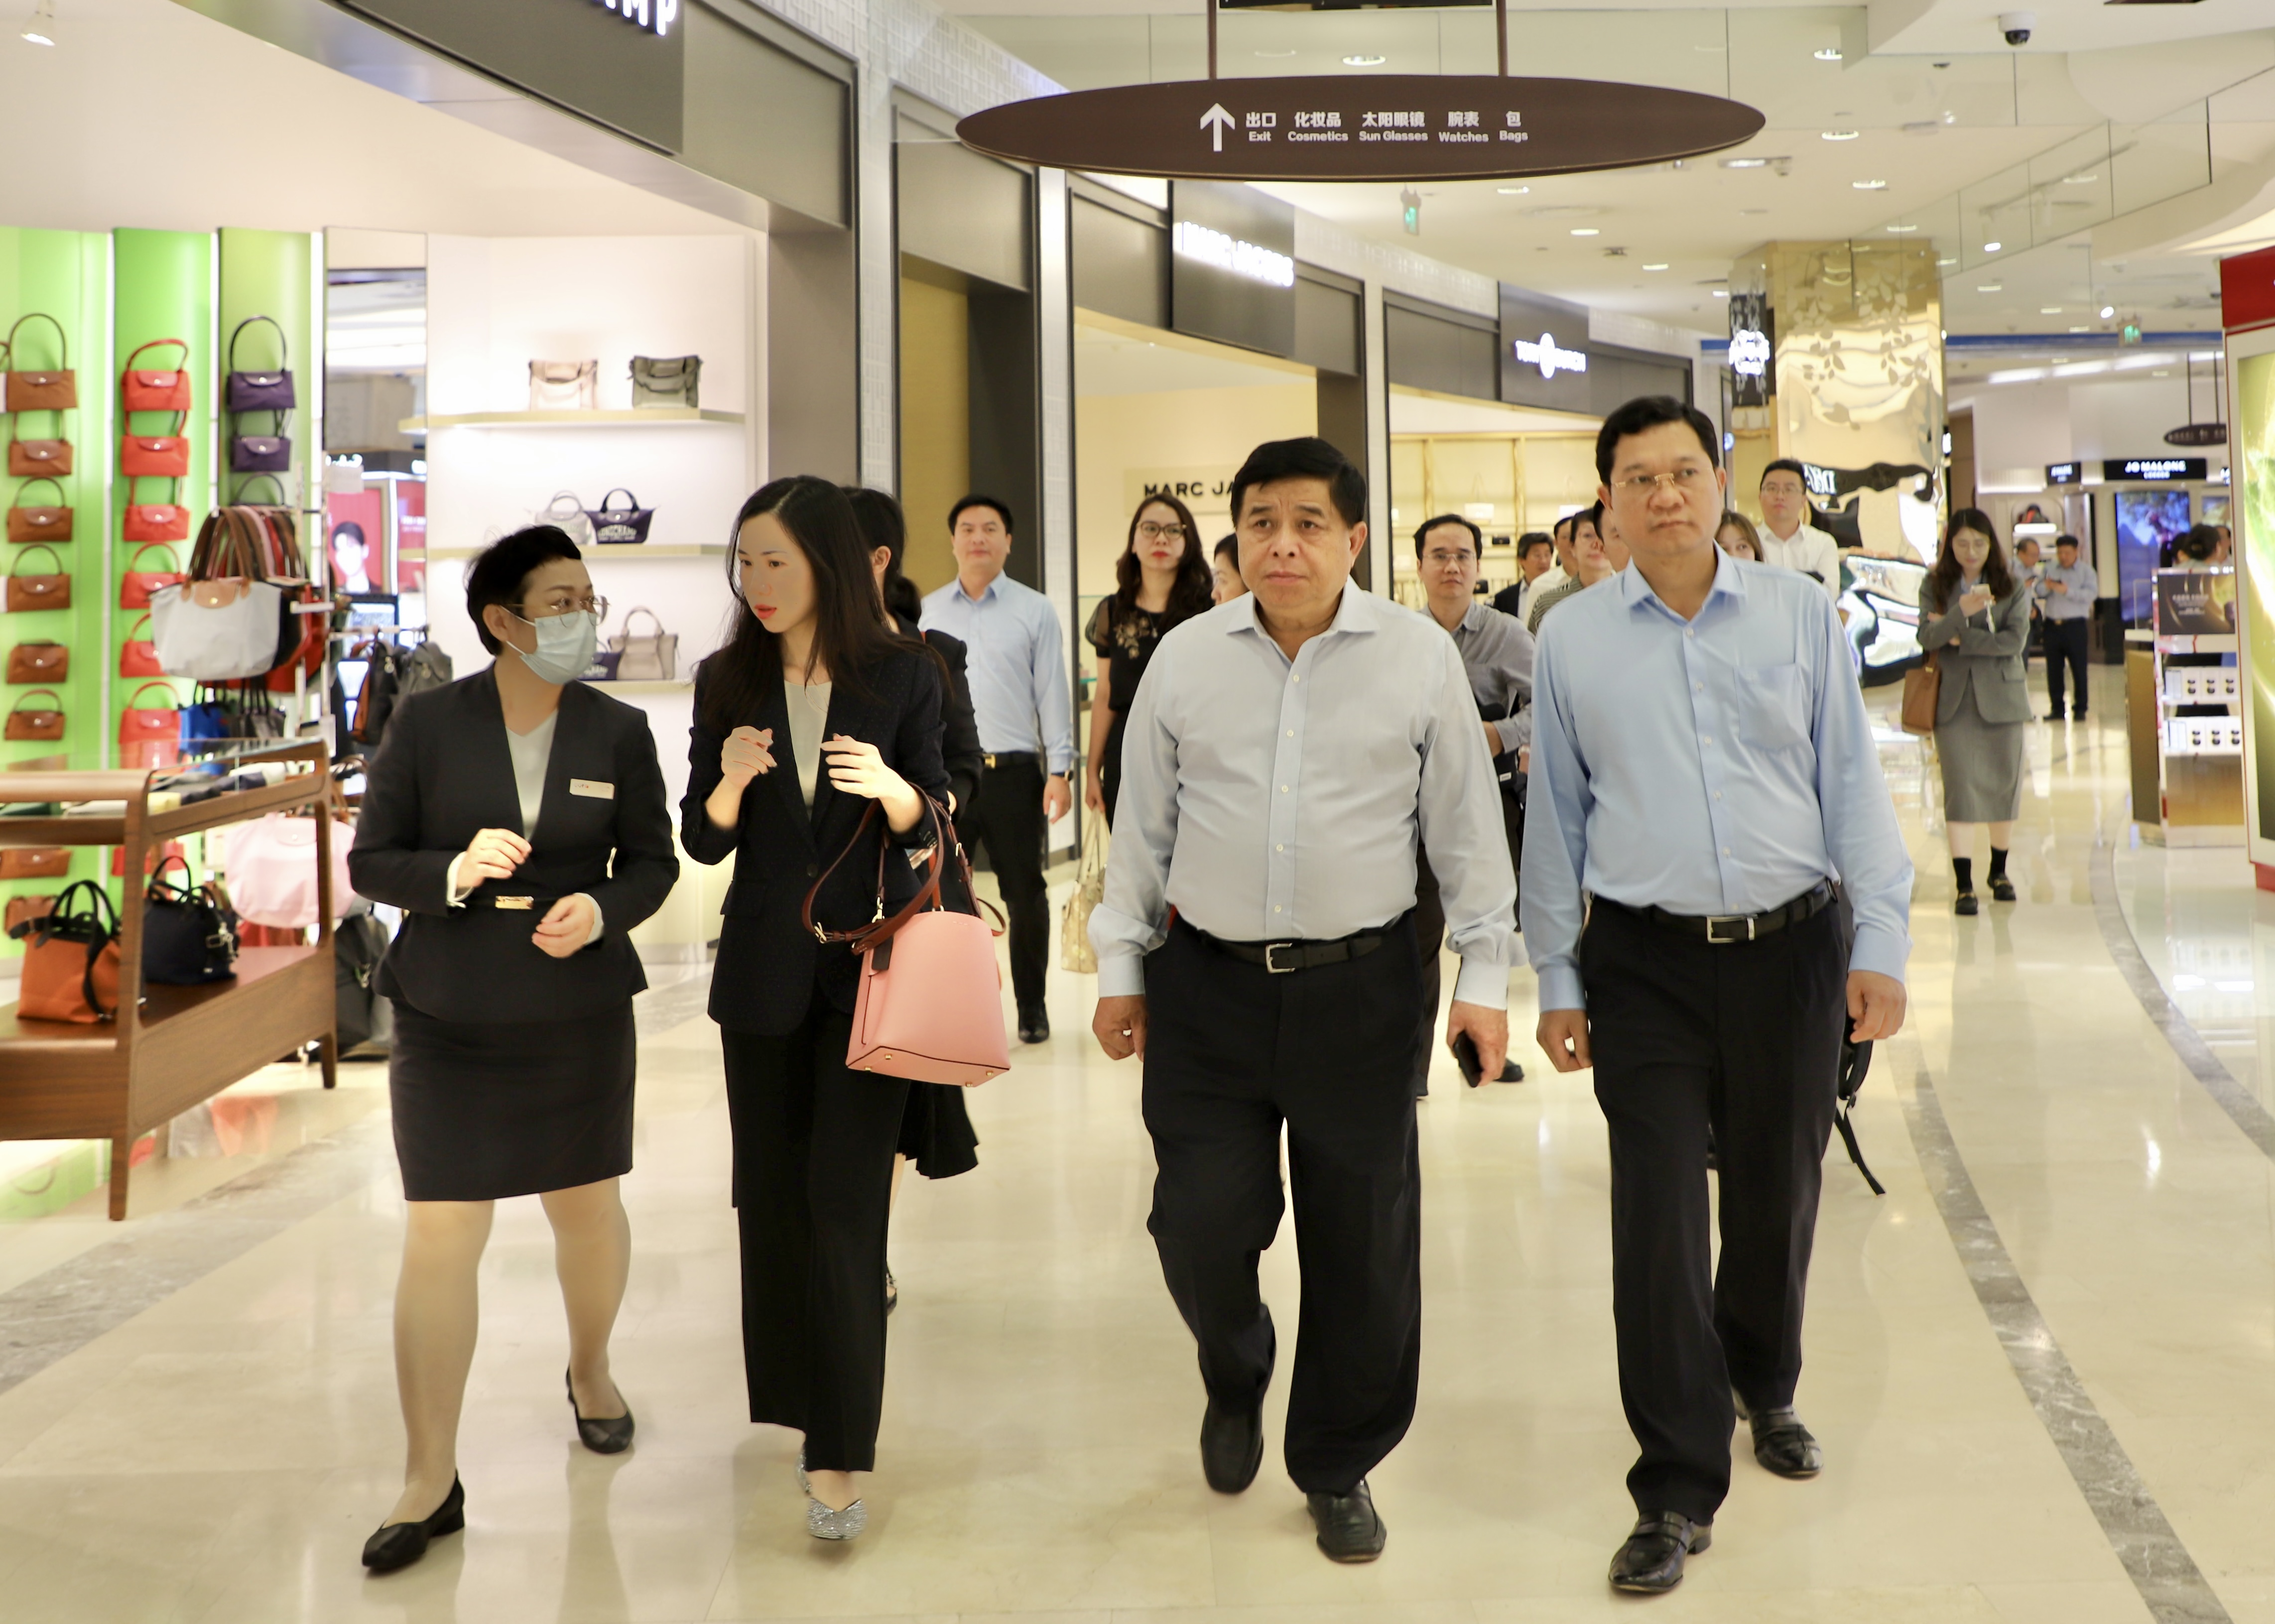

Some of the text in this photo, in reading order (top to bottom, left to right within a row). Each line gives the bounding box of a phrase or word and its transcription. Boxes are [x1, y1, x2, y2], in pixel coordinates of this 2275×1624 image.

[1246, 111, 1521, 127] 出口 化妆品 太阳眼镜 腕表 包
[1249, 130, 1528, 143] Exit Cosmetics Sun Glasses Watches Bags
[1144, 482, 1204, 497] MARC
